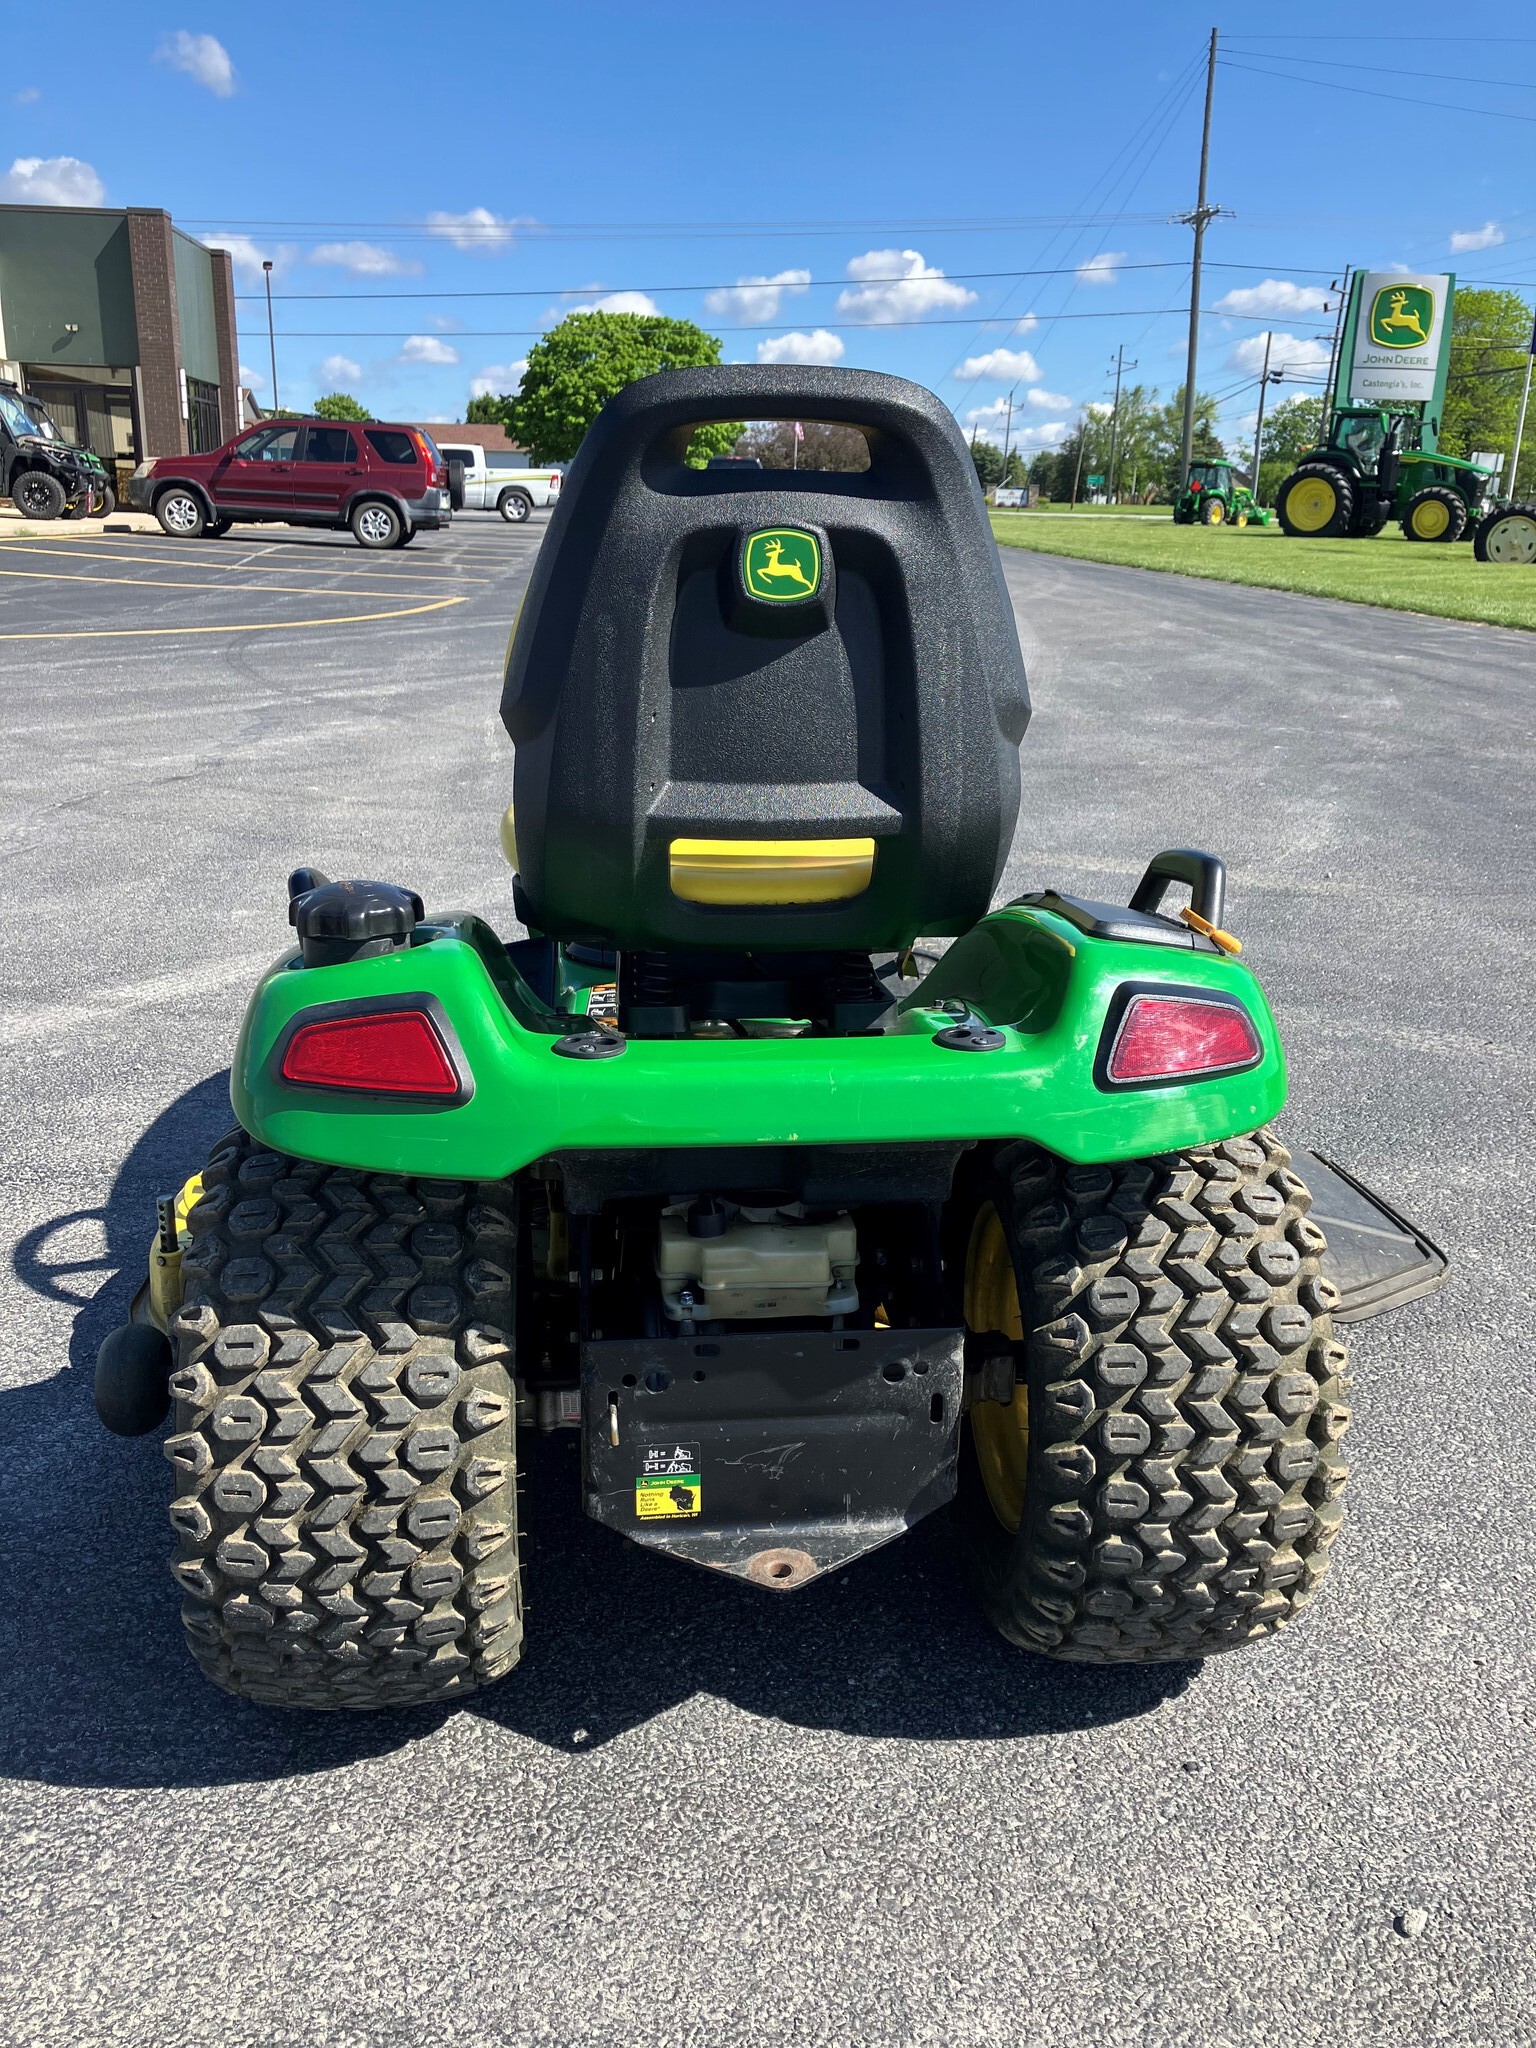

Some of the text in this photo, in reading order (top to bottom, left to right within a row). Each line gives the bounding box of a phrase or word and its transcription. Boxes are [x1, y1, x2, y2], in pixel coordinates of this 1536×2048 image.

[1363, 354, 1429, 365] JOHN DEERE
[1410, 380, 1424, 389] Inc.
